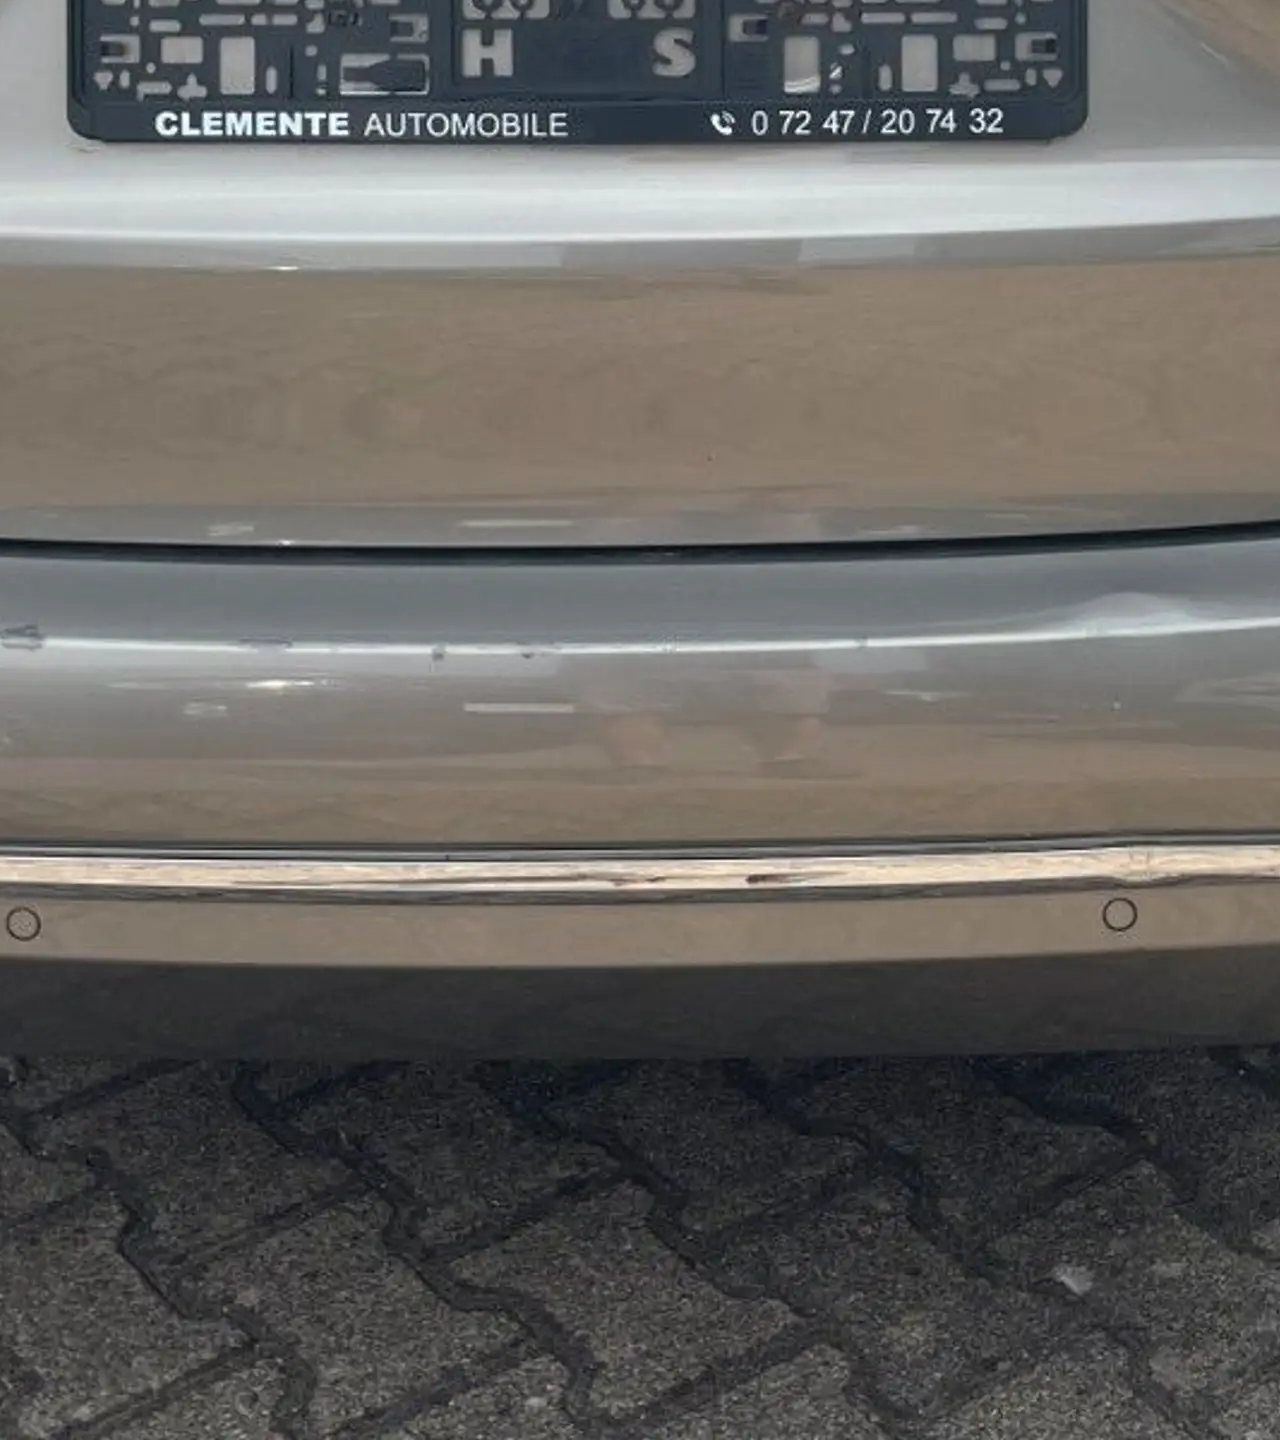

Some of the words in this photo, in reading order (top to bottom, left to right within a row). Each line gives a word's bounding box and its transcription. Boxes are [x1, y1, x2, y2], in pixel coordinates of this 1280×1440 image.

[154, 111, 350, 137] CLEMENTE
[363, 111, 569, 138] AUTOMOBILE
[751, 110, 769, 136] 0
[778, 110, 812, 136] 72
[925, 109, 957, 134] 74
[969, 108, 1005, 135] 32
